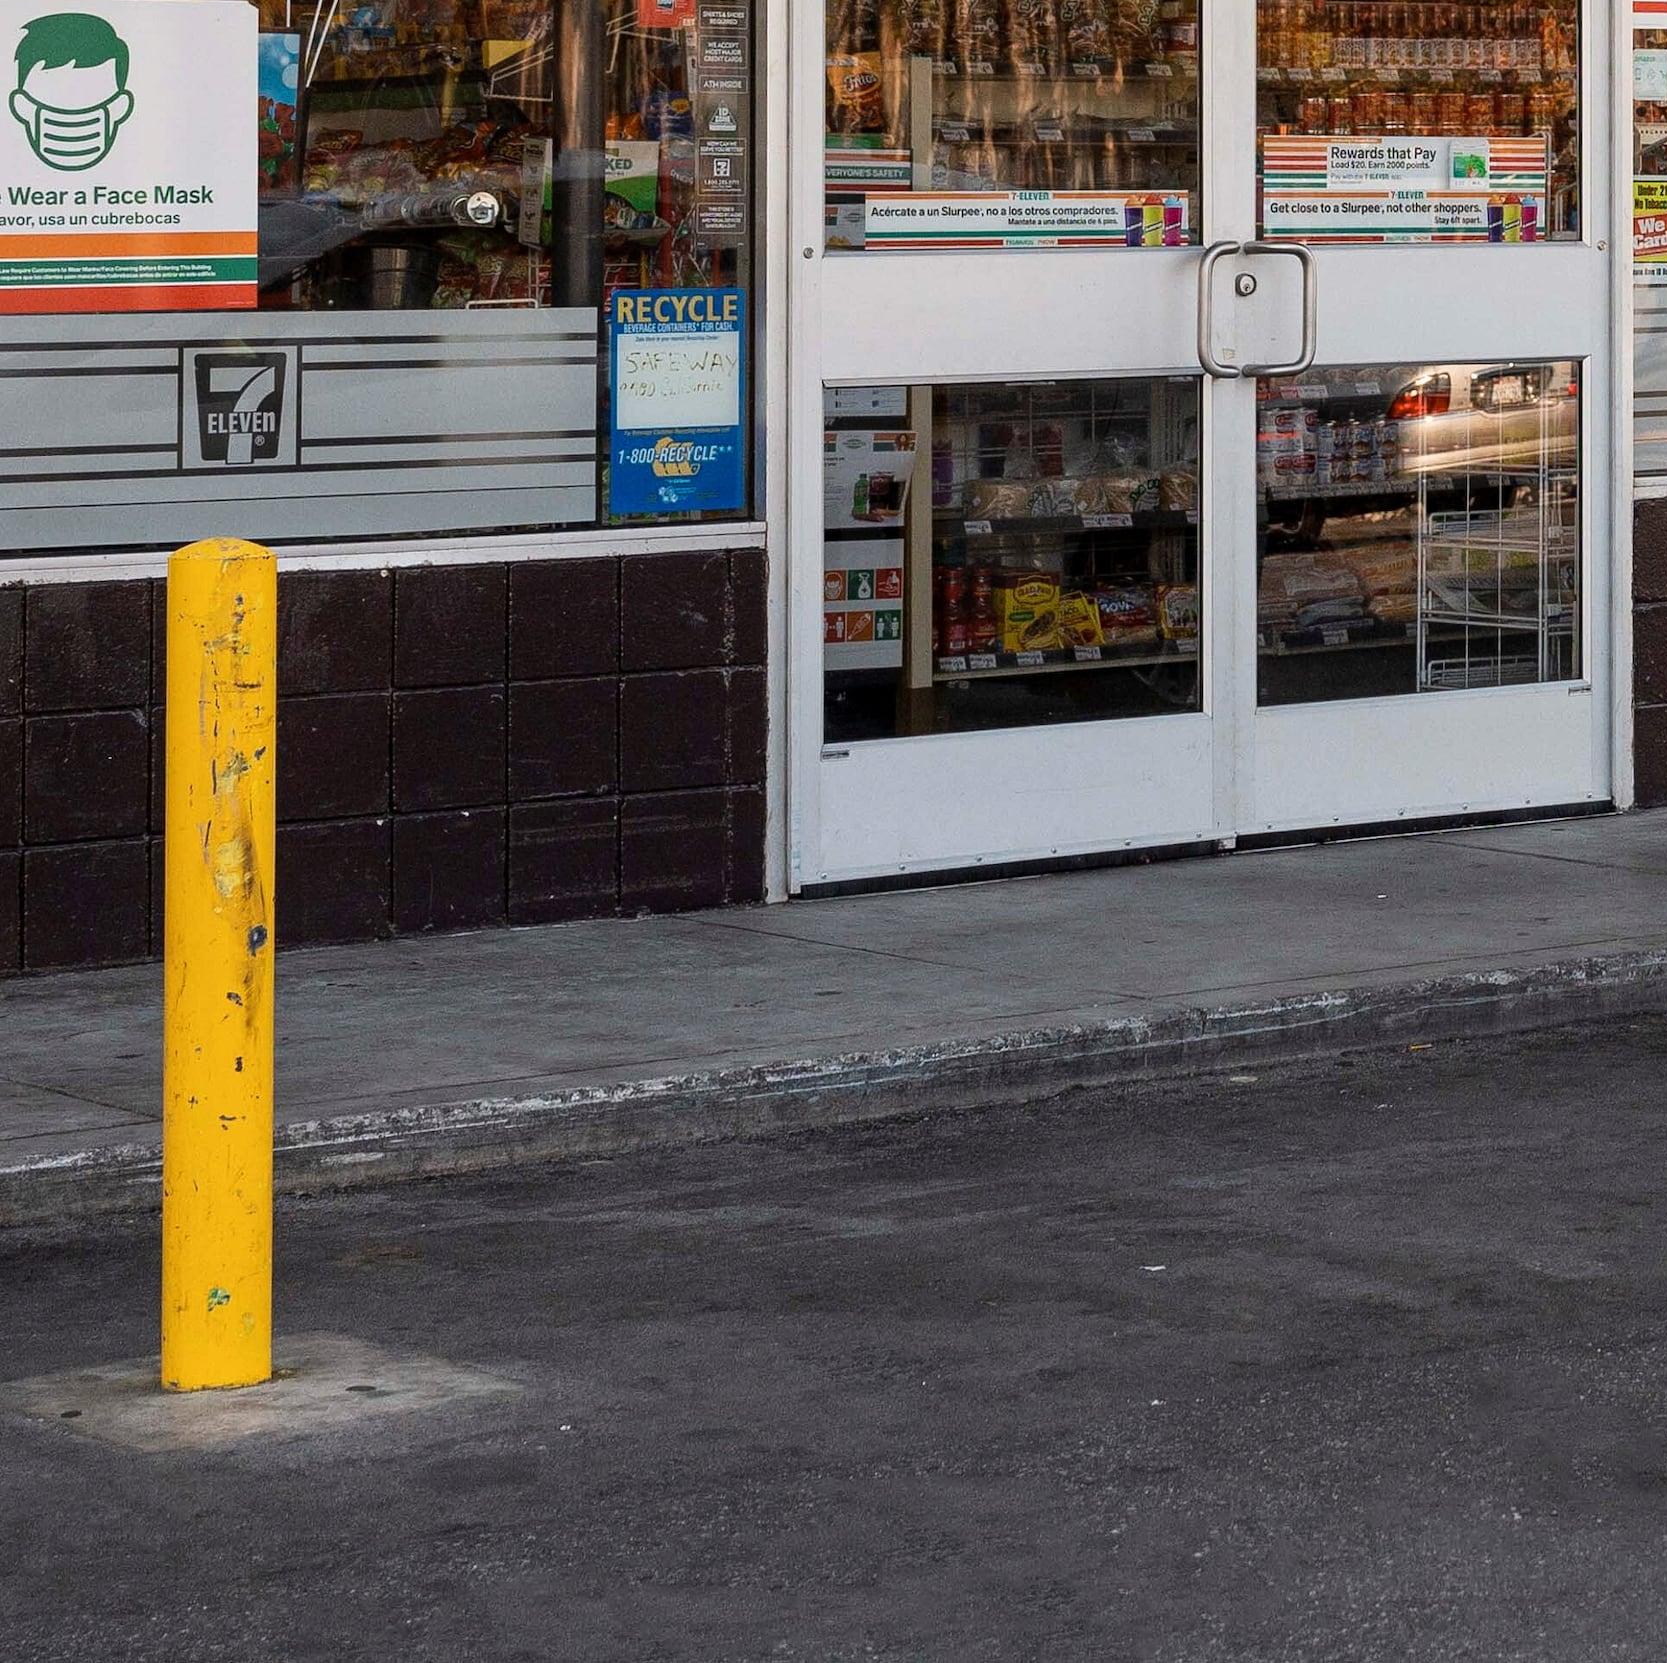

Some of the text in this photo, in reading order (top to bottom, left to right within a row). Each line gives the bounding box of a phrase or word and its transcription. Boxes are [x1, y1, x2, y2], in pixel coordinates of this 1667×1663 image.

[844, 72, 878, 92] Fritos
[1331, 146, 1436, 162] Rewards that Pay
[1331, 161, 1430, 170] Load $20. Earn 2000 points.
[825, 168, 903, 178] VERYONE'S SAFETY
[8, 185, 214, 206] Wear a Face Mask
[1637, 184, 1667, 196] Under 21
[871, 206, 917, 217] Acércate
[919, 209, 925, 217] a
[927, 209, 940, 217] un
[986, 208, 999, 217] no
[1001, 208, 1007, 216] a
[1008, 206, 1023, 216] los
[1025, 206, 1051, 217] otros
[1053, 206, 1118, 218] compradores.
[1270, 203, 1290, 214] Get
[1291, 203, 1318, 214] close
[1320, 203, 1331, 214] to
[1333, 205, 1339, 213] a
[1387, 203, 1403, 213] not
[1405, 203, 1432, 213] other
[1433, 203, 1482, 215] shoppers.
[39, 214, 65, 225] usa
[69, 214, 87, 225] un
[91, 212, 181, 225] cubrebocas
[1434, 216, 1449, 224] Stay
[1461, 216, 1482, 225] apart.
[1637, 217, 1666, 234] We
[617, 295, 738, 324] RECYCLE
[623, 323, 656, 334] BEVERAGE
[700, 323, 714, 332] FOR
[624, 350, 738, 376] SAFEWAY
[210, 366, 275, 464] 7
